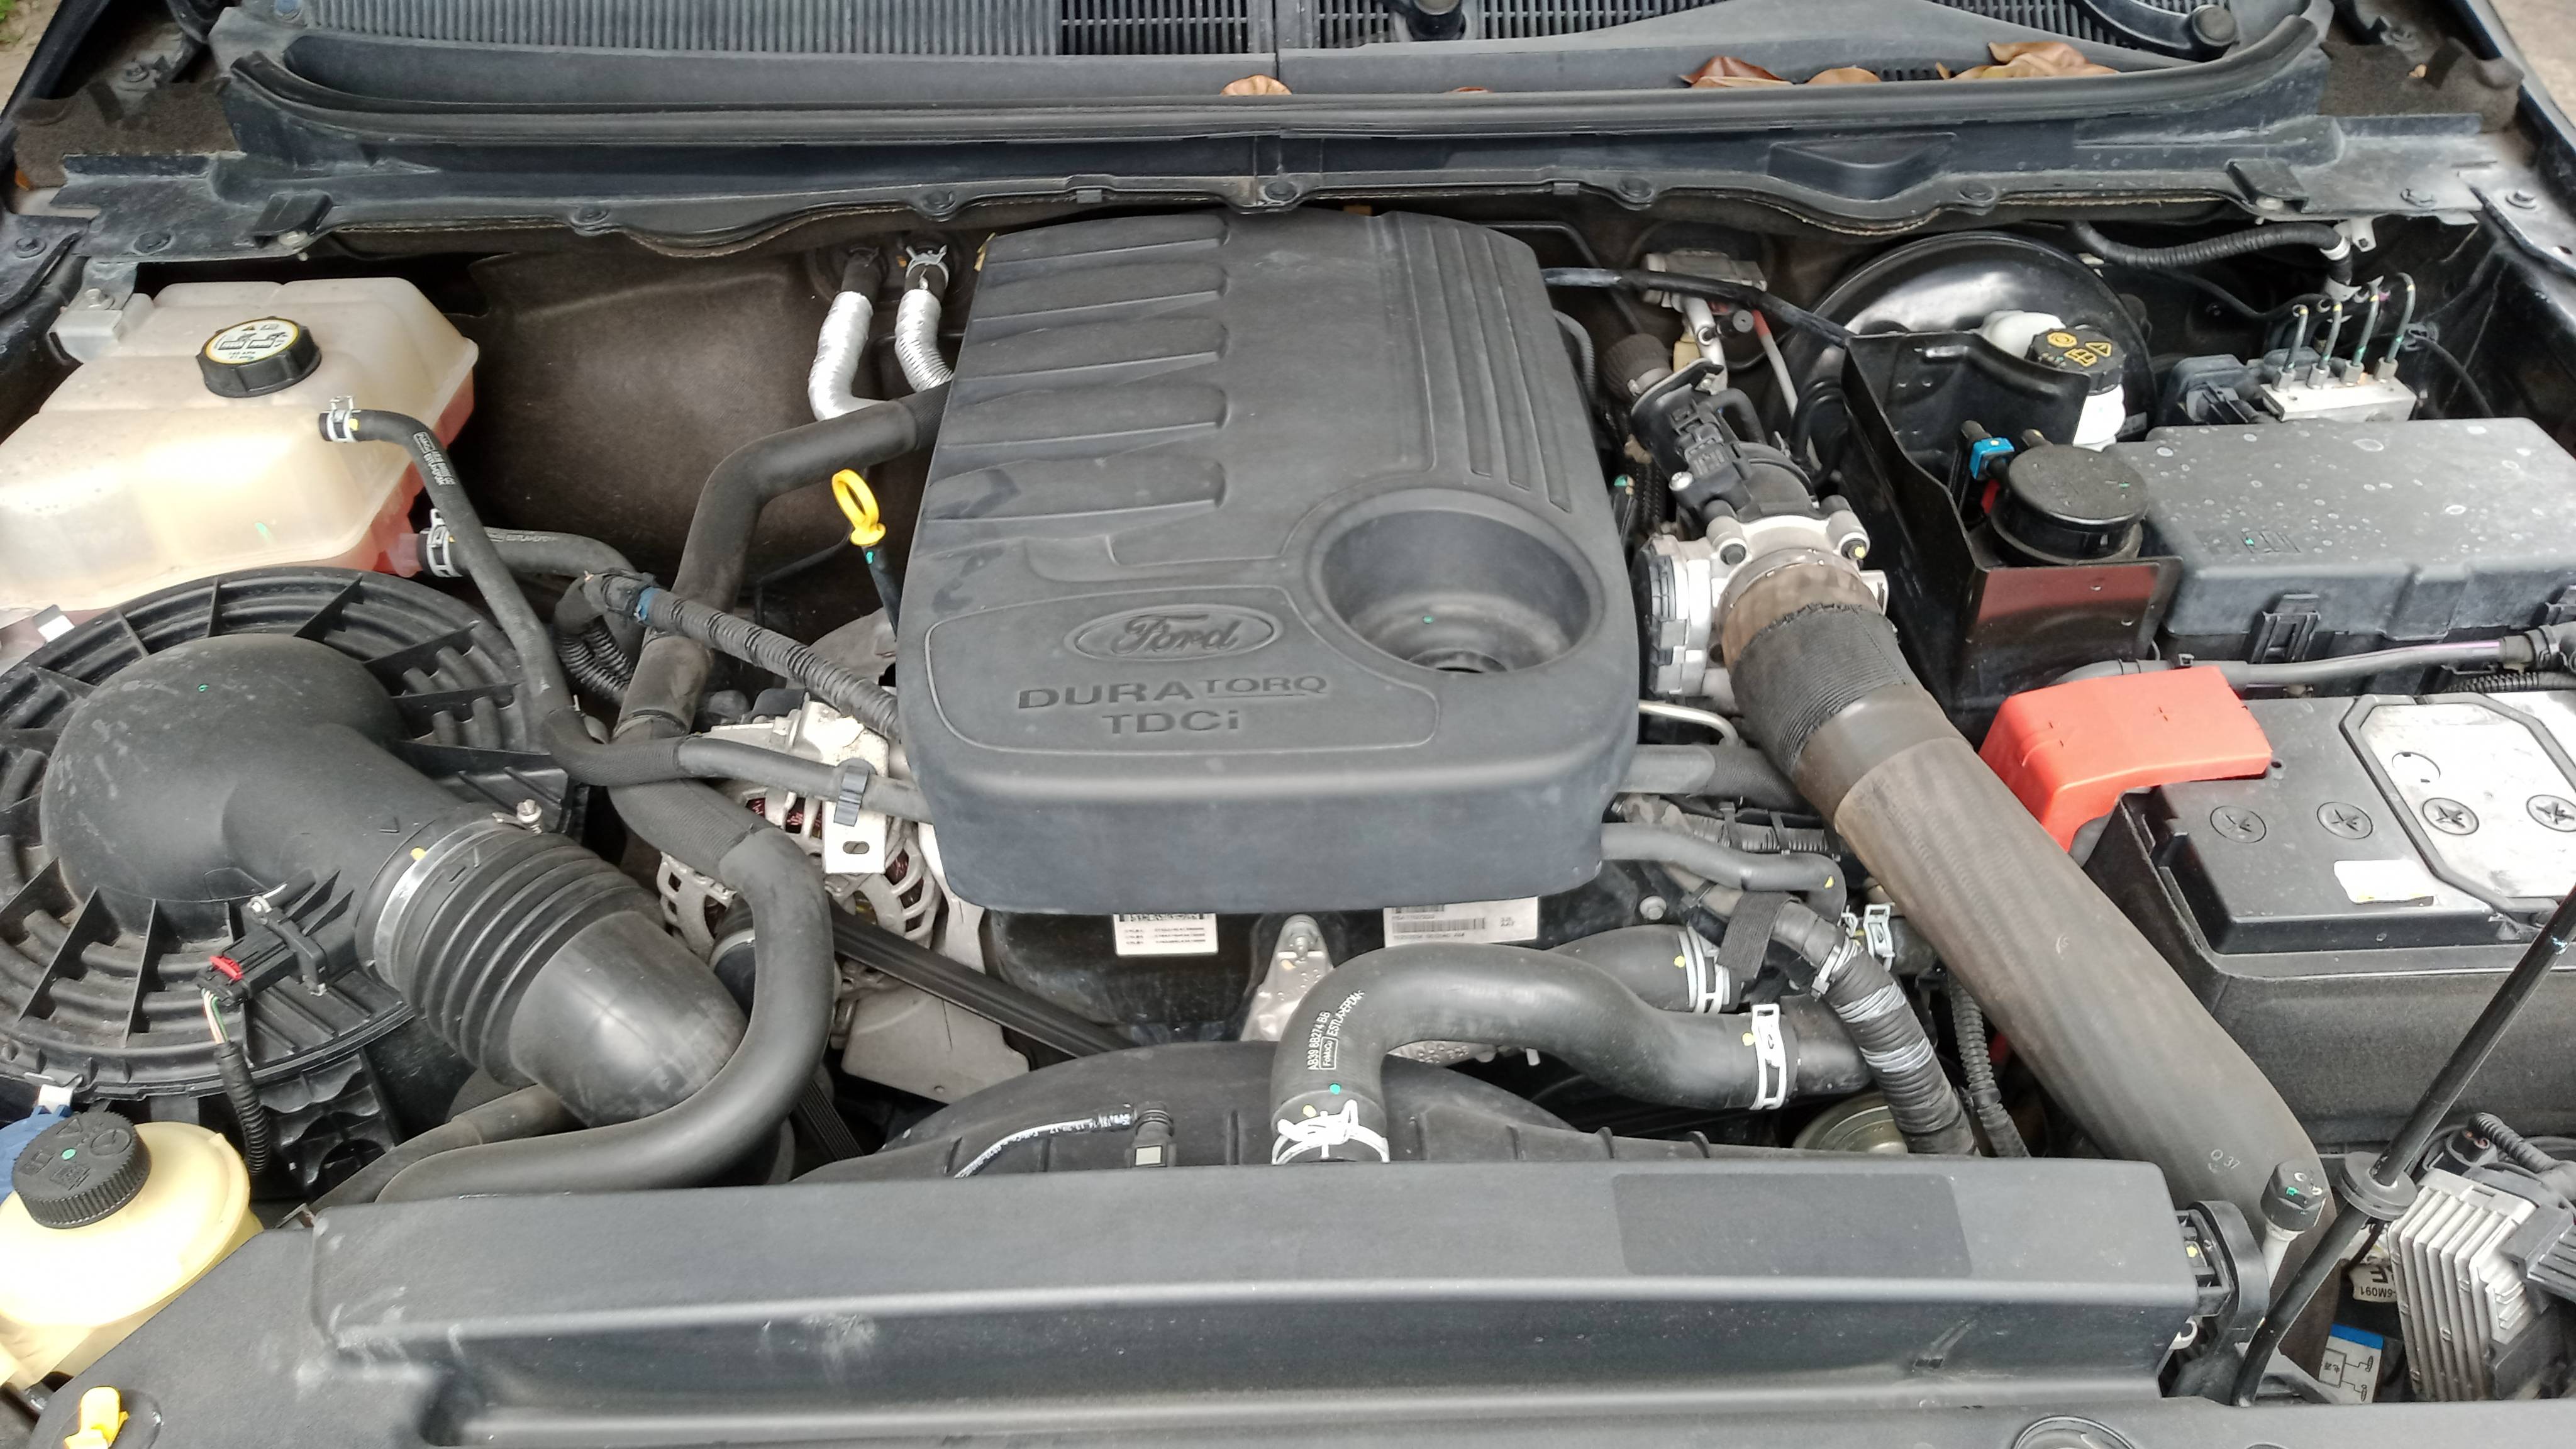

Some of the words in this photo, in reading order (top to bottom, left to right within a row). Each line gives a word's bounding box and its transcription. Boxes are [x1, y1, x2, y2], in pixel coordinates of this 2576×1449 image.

[1111, 614, 1242, 655] Ford
[1102, 709, 1240, 735] TDCi
[1309, 1024, 1326, 1048] 8B274
[1307, 1049, 1319, 1070] AB39
